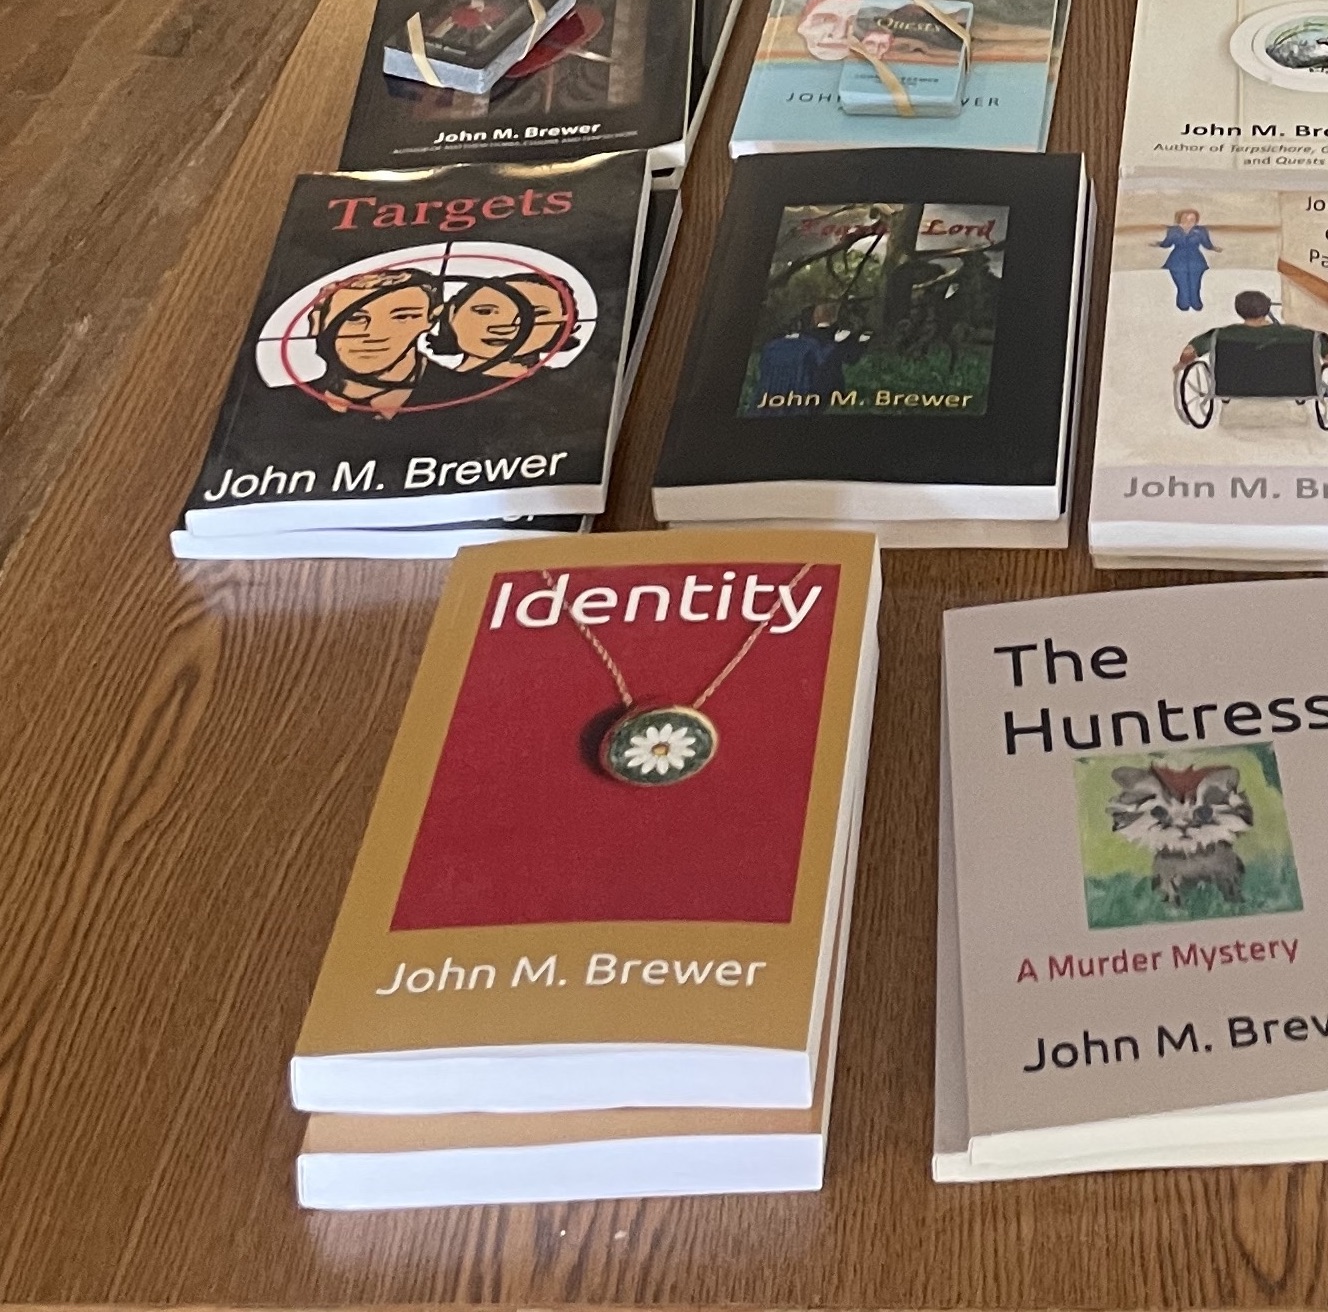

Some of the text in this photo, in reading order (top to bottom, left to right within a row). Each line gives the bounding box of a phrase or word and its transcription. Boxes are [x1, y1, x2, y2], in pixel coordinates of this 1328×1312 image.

[433, 130, 487, 145] John
[493, 128, 519, 140] M.
[524, 123, 602, 138] Brewer
[1153, 142, 1205, 152] Author
[1209, 143, 1225, 152] of
[1180, 123, 1242, 137] John
[1251, 124, 1286, 137] M.
[1243, 156, 1326, 166] and Quests
[328, 187, 574, 234] Targets
[756, 389, 974, 409] John M. Brewer
[203, 449, 569, 504] John M. Brewer
[1123, 475, 1216, 500] John
[1229, 475, 1281, 500] M.
[487, 570, 824, 635] Identity
[993, 637, 1130, 688] The
[375, 952, 768, 997] John M. Brewer
[1016, 937, 1301, 984] A Murder Mystery
[1023, 1029, 1141, 1074] John
[1156, 1022, 1214, 1058] M.
